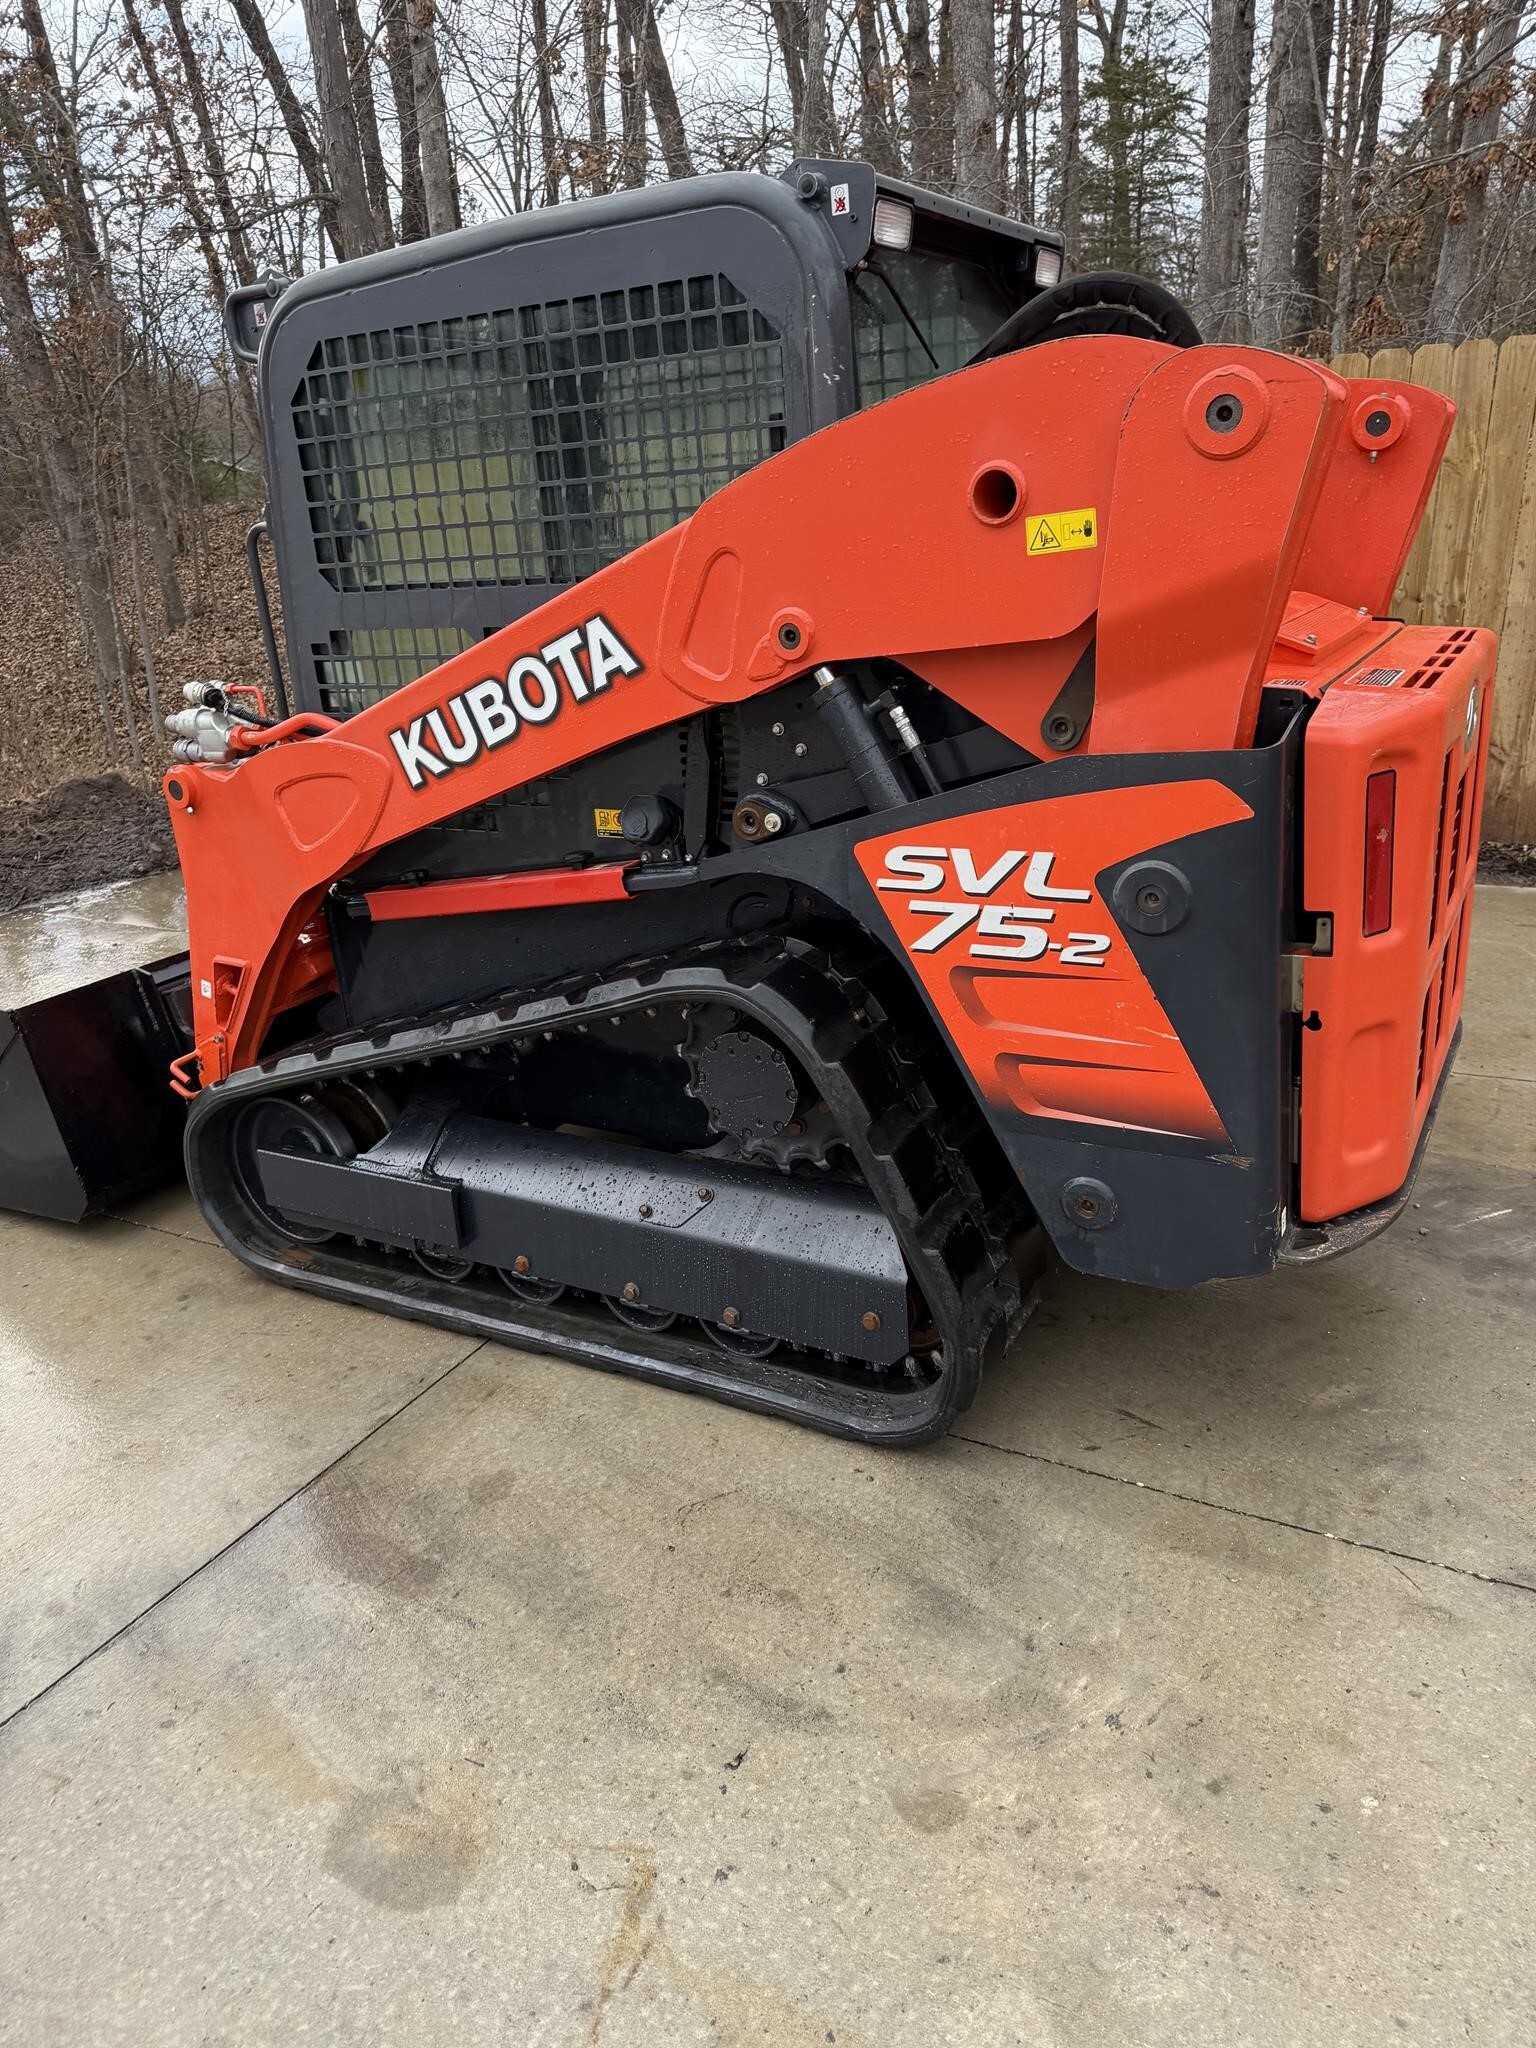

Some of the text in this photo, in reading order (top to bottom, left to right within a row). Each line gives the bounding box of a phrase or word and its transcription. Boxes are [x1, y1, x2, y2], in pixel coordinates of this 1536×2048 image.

[388, 615, 642, 790] KUBOTA
[876, 845, 1092, 902] SVL
[908, 900, 1112, 966] 75-2
